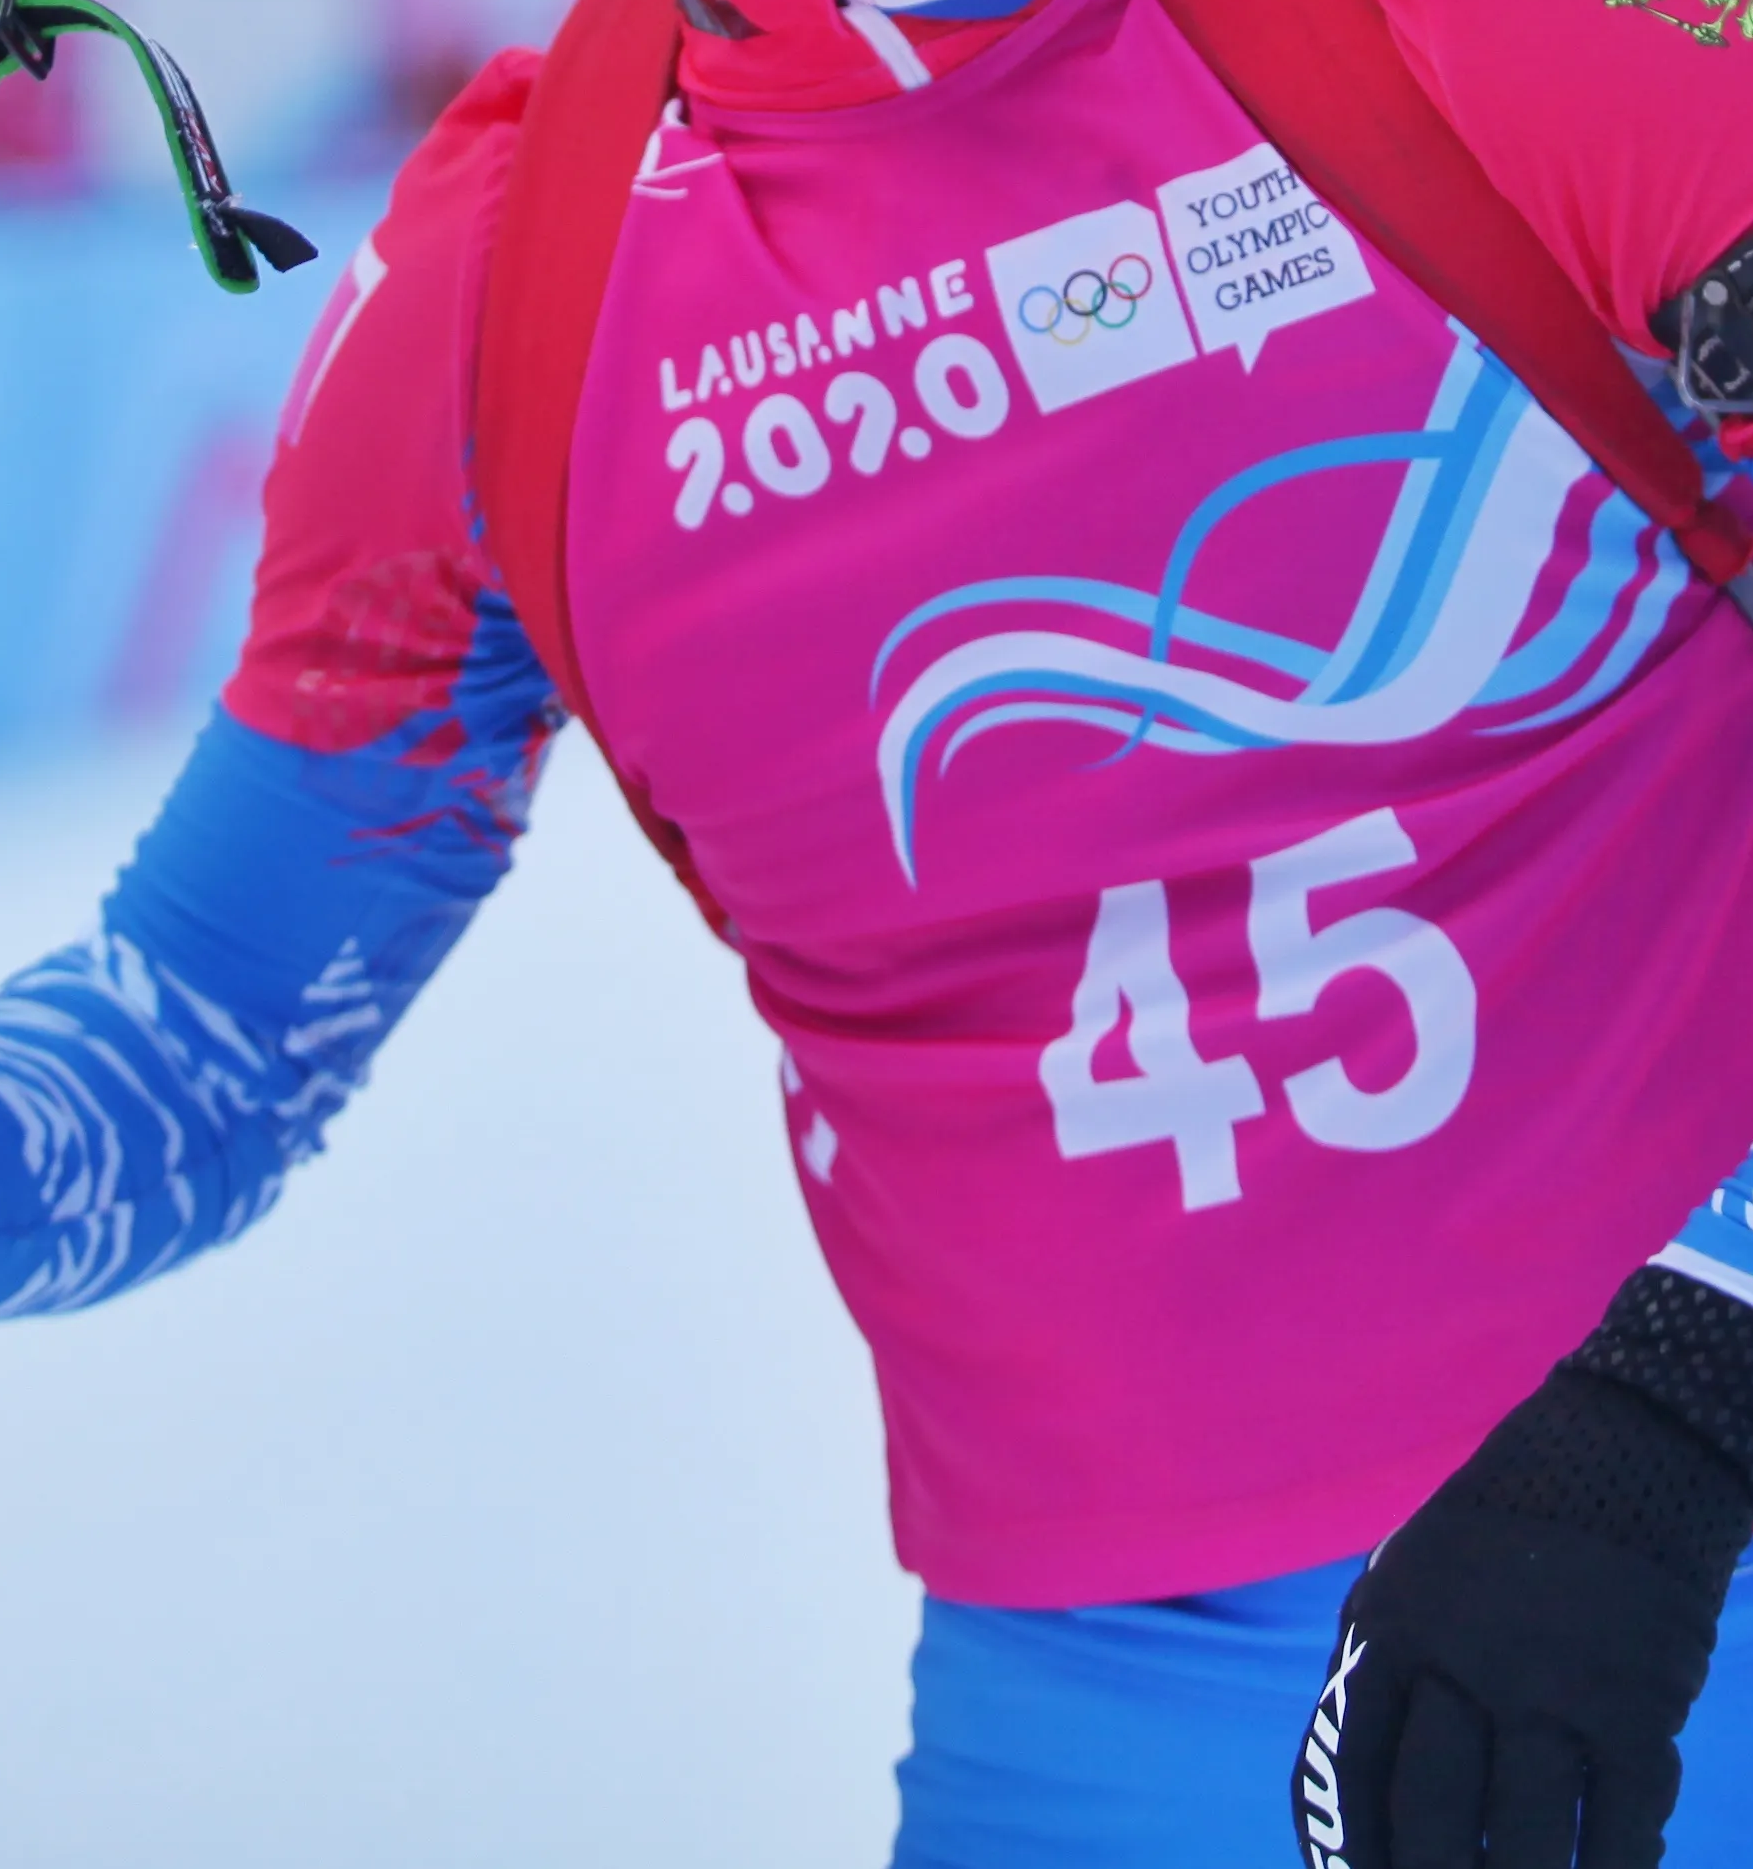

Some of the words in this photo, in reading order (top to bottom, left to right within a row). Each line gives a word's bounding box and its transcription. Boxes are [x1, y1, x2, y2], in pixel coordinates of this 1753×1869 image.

[1186, 164, 1299, 228] YOUTH
[1186, 200, 1330, 274] OLYMPIC
[659, 258, 974, 412] LAUSANNE
[1215, 246, 1335, 311] GAMES
[665, 333, 1010, 530] 2020
[1038, 806, 1477, 1212] 45
